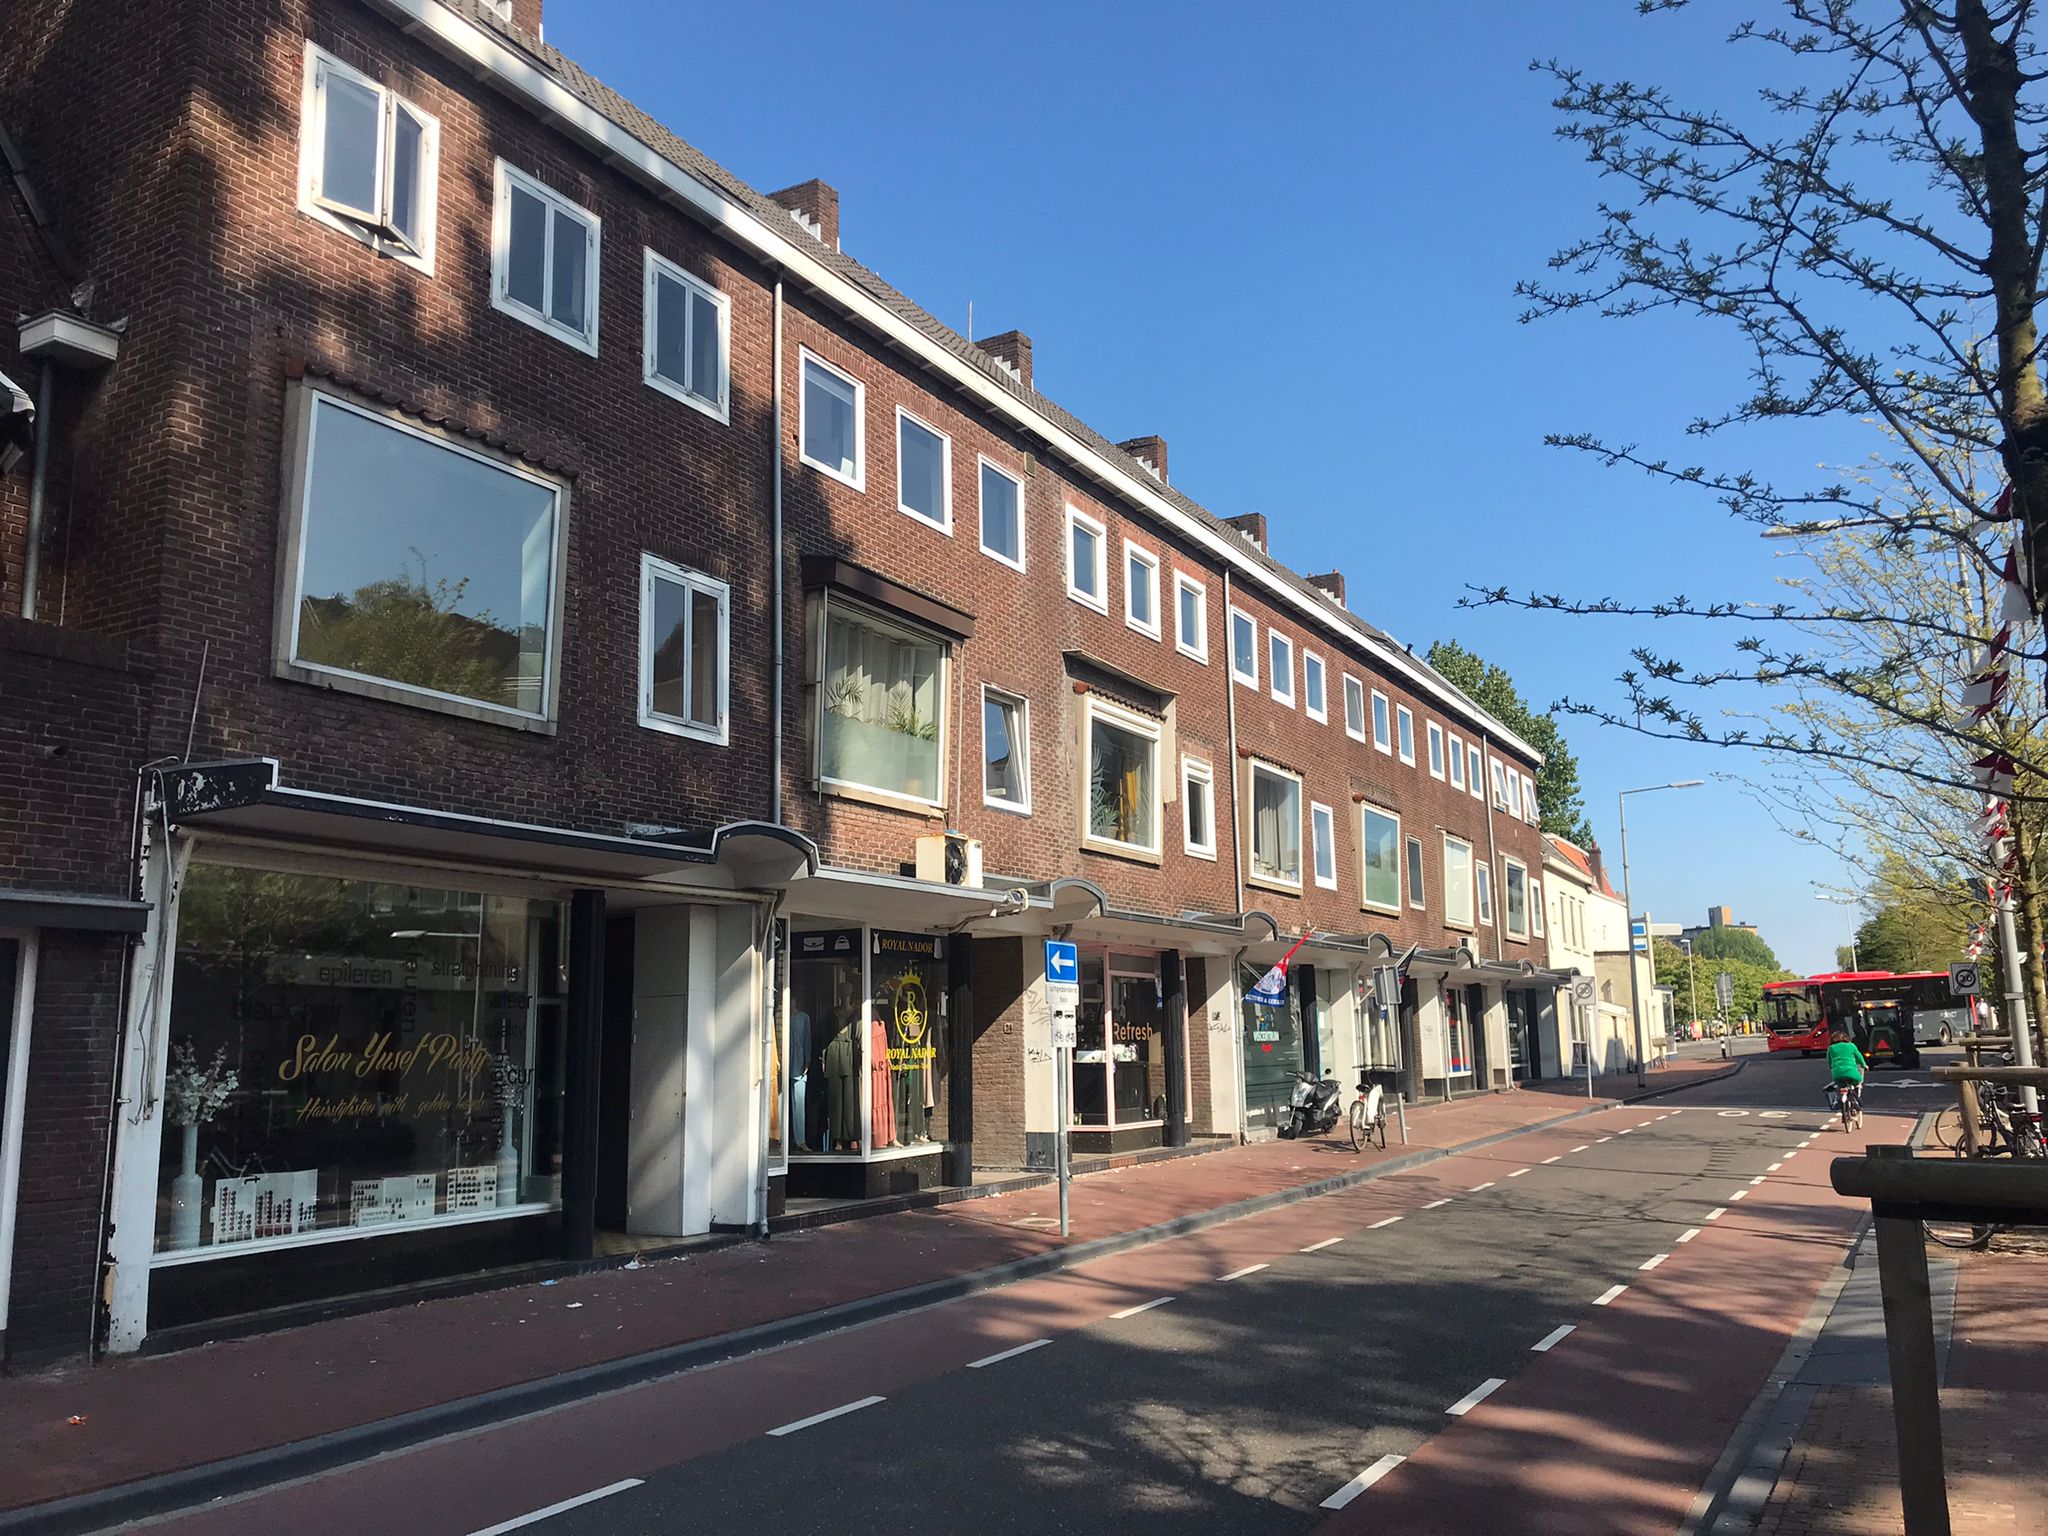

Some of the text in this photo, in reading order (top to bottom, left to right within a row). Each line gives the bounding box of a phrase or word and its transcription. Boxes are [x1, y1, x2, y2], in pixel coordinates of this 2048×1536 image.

[882, 939, 933, 953] ROYAL NADOR
[318, 961, 392, 985] epileren
[1960, 974, 1972, 983] 30
[1113, 1022, 1153, 1041] Refresh
[278, 1033, 352, 1081] Salon
[355, 1032, 432, 1082] Yusef
[886, 1048, 910, 1060] ROYAL
